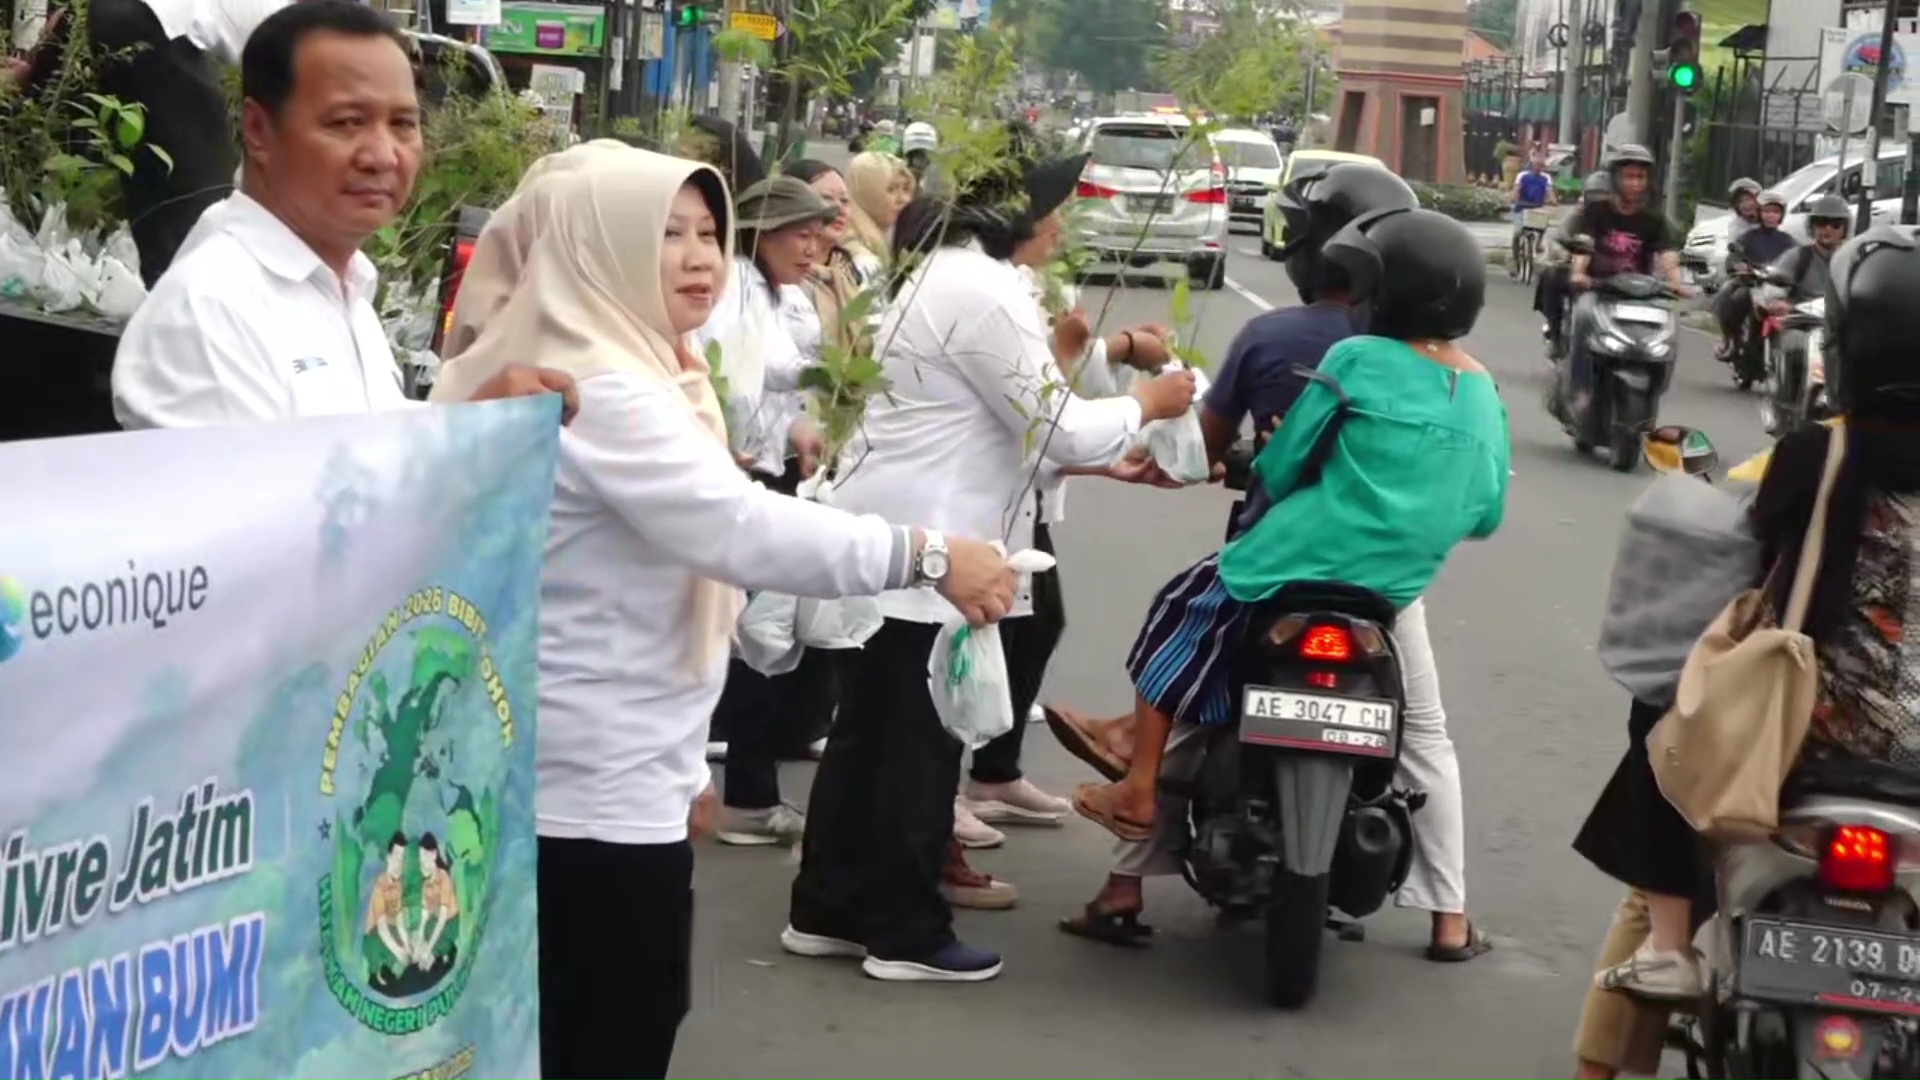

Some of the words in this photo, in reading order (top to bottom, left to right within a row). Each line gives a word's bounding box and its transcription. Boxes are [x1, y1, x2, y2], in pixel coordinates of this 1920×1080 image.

[30, 559, 208, 640] econique
[320, 607, 400, 796] PEMBAGIAN
[403, 585, 443, 623] 2026
[480, 645, 514, 750] OHON
[1255, 697, 1282, 717] AE
[1294, 700, 1346, 723] 3047
[1360, 708, 1387, 729] CH
[113, 781, 252, 904] Jatim
[137, 917, 264, 1067] BUMI
[1758, 930, 1795, 960] AE
[1811, 935, 1884, 970] 2139
[1898, 945, 1920, 974] D
[358, 999, 427, 1035] NEGERI
